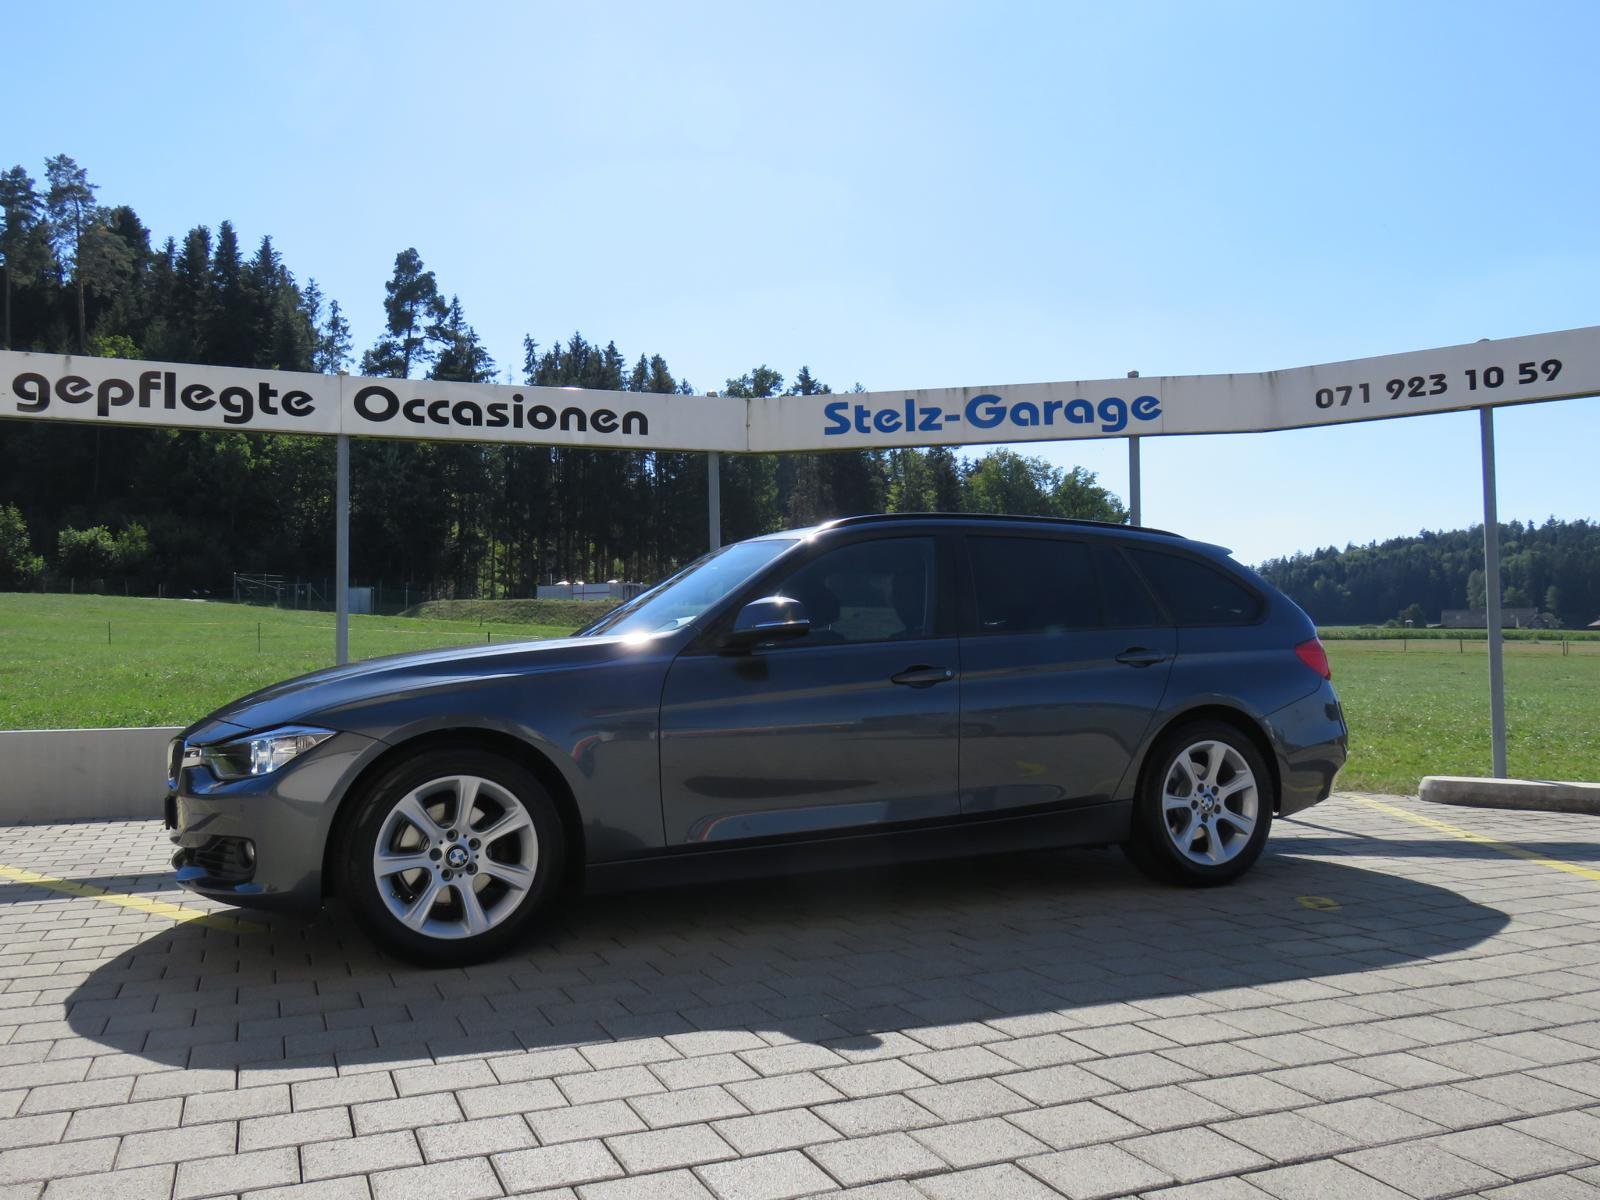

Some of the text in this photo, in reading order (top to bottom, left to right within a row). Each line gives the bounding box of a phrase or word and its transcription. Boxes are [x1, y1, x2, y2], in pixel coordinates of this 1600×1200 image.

[12, 371, 649, 435] gepflegte Occasionen
[1316, 359, 1563, 409] 071 923 10 59
[824, 393, 1162, 436] Stelz-Garage
